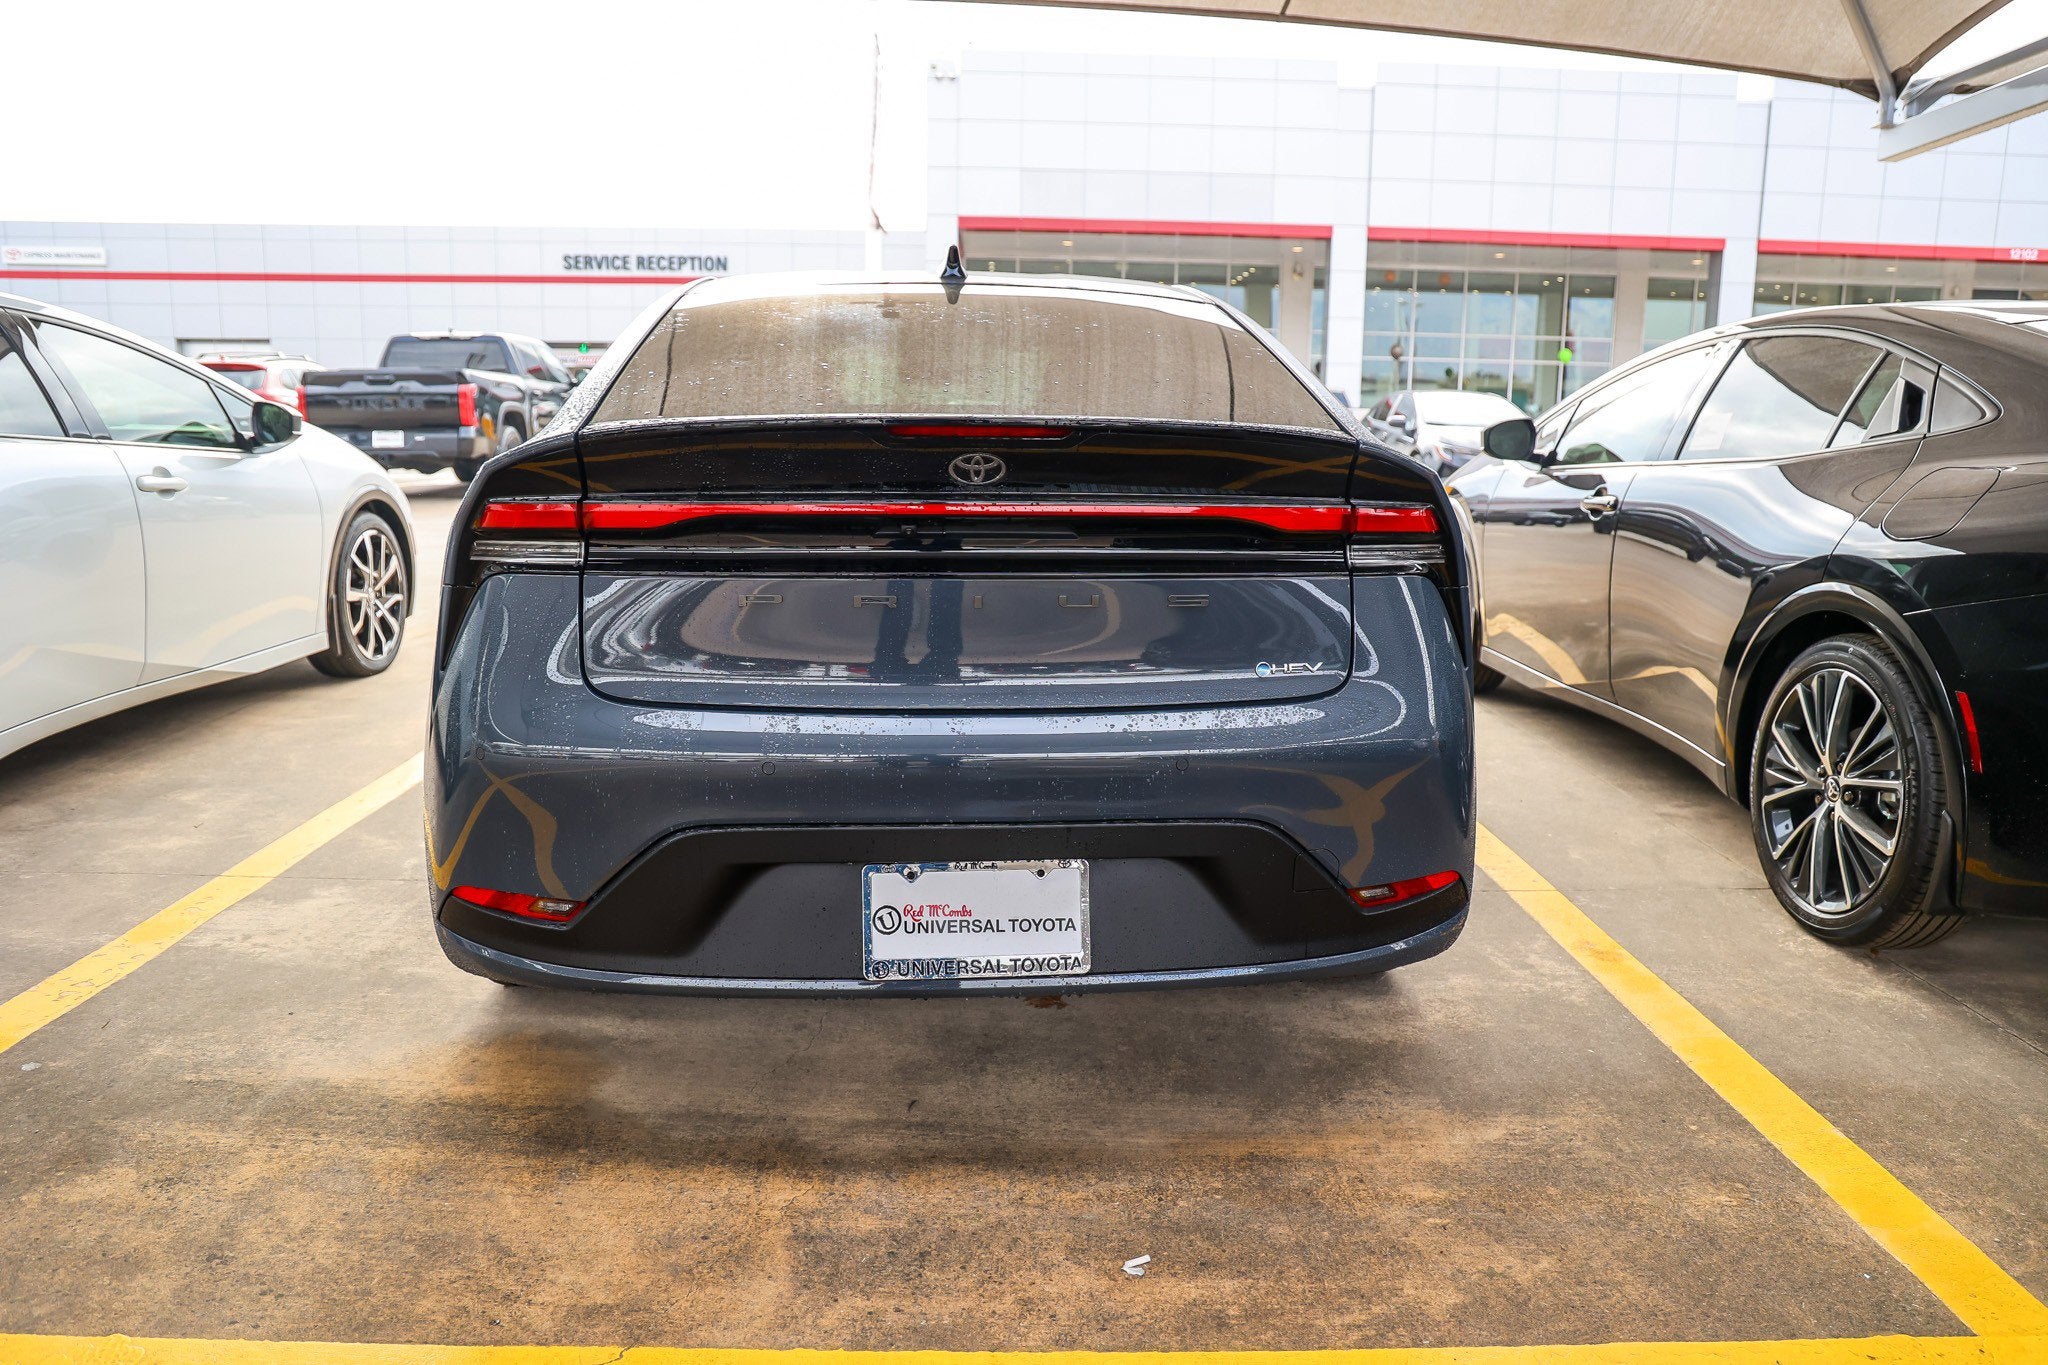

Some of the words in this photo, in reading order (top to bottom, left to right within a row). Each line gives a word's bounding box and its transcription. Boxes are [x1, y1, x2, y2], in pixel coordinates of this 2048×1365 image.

[563, 255, 630, 270] SERVICE
[636, 255, 728, 271] RECEPTION
[738, 594, 1210, 608] PRIUS
[1271, 661, 1323, 674] HEV
[903, 904, 924, 922] Red
[904, 919, 1006, 934] UNIVERSAL
[1008, 918, 1077, 932] TOYOTA
[897, 959, 1008, 976] UNIVERSAL
[1010, 955, 1082, 973] TOYOTA
